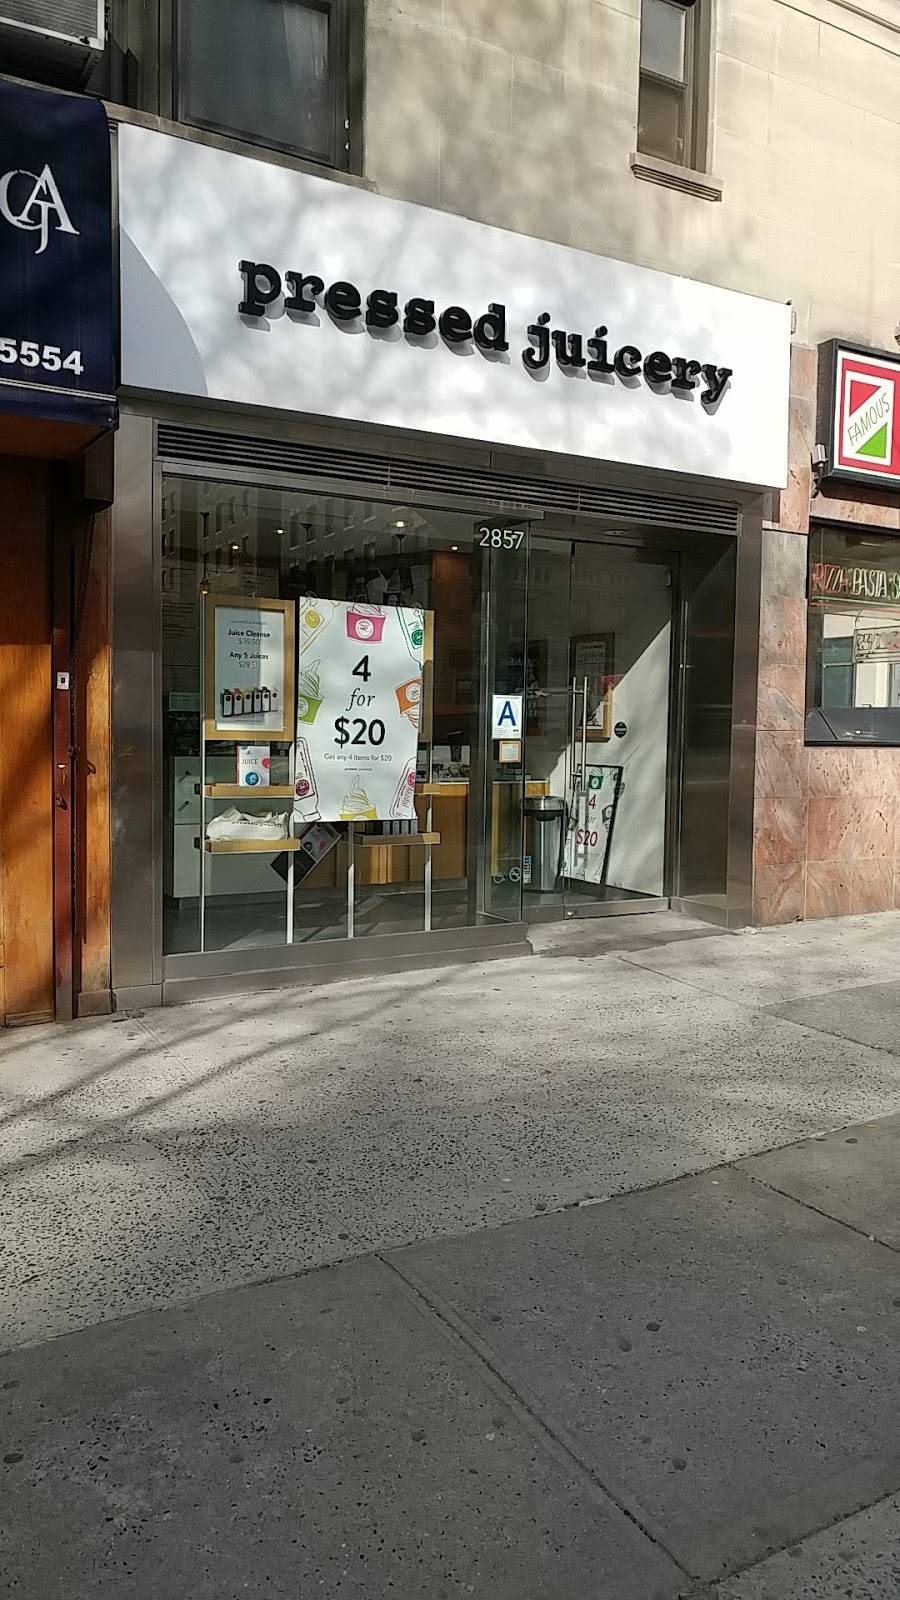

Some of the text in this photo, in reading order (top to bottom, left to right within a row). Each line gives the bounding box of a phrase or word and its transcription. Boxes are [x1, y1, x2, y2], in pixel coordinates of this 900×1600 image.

[237, 259, 733, 404] pressed juicery
[0, 337, 84, 375] 5554
[847, 392, 890, 446] FAMOUS
[479, 527, 525, 550] 2857
[850, 567, 887, 598] PASTA
[228, 628, 271, 639] Juice Cleanse
[229, 651, 242, 660] Any
[352, 655, 371, 682] 4
[345, 687, 375, 711] for
[497, 700, 516, 726] A
[334, 715, 386, 749] $20
[324, 752, 335, 760] Get
[336, 754, 348, 762] any
[353, 753, 370, 761] items
[380, 754, 392, 762] $20
[588, 794, 597, 809] 4
